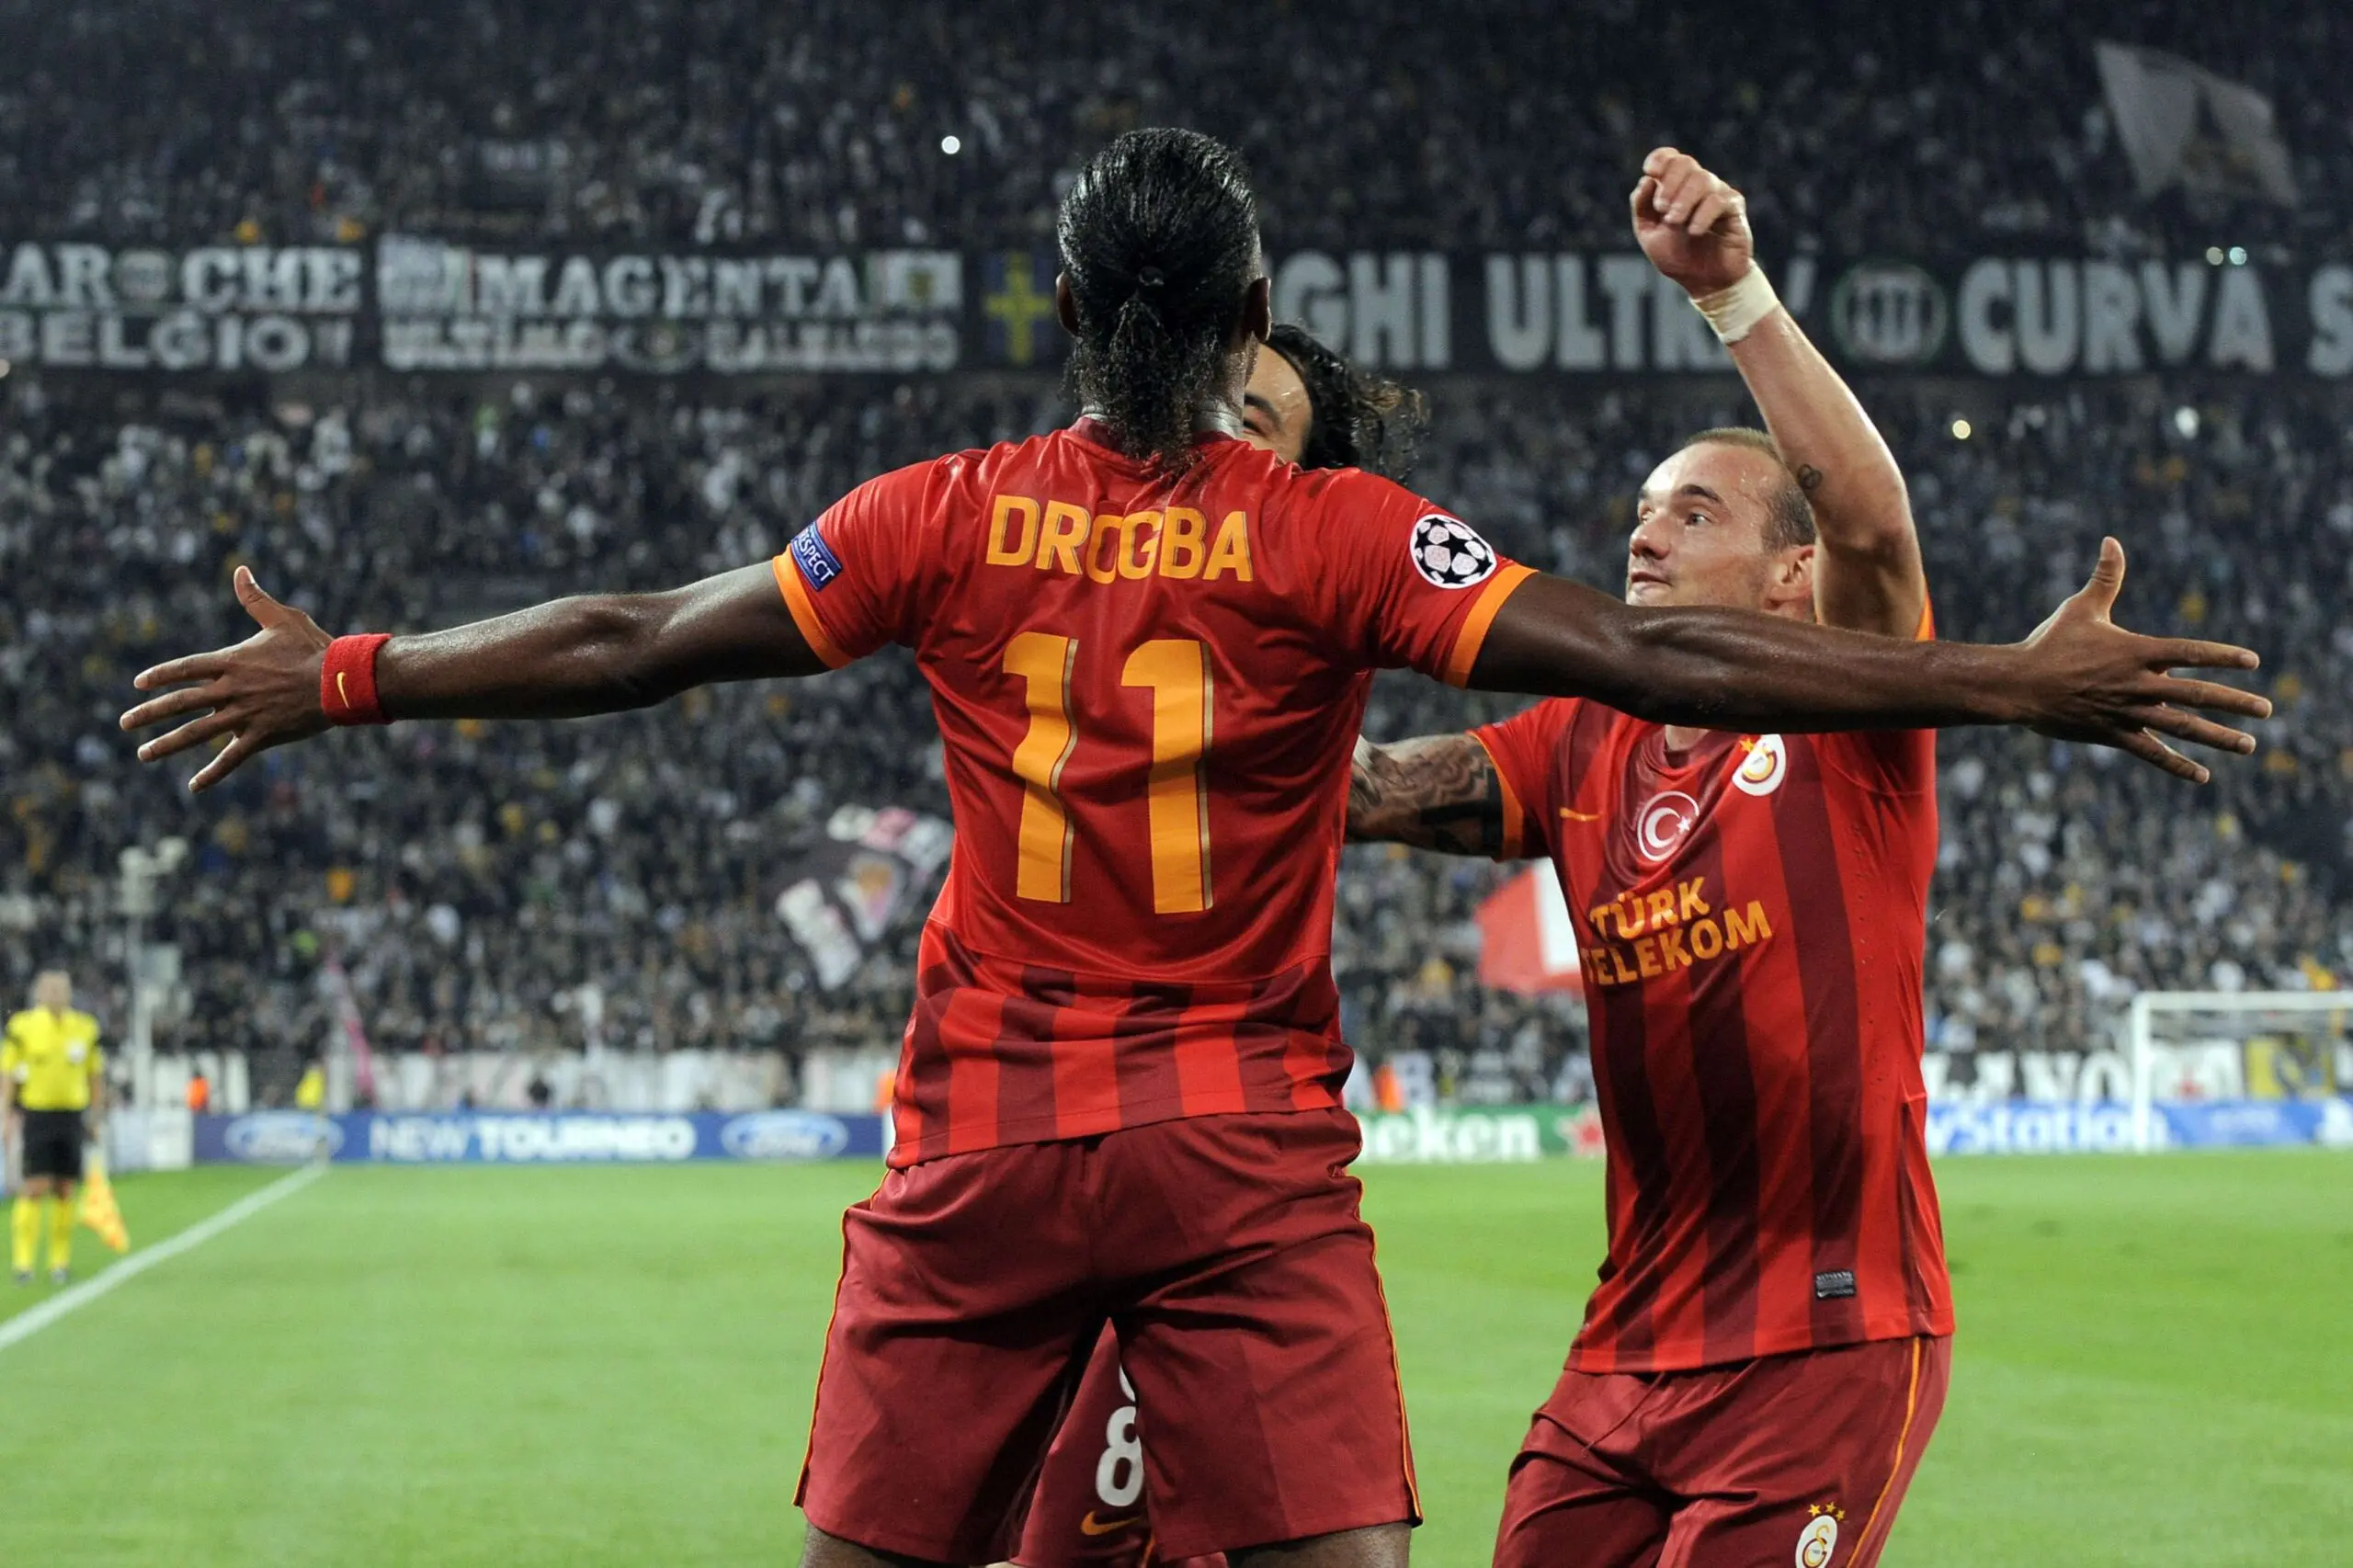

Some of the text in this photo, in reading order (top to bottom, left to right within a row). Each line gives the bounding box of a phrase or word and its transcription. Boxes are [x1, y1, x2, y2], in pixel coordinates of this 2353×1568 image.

[475, 252, 860, 317] MAGENTA
[1956, 256, 2273, 376] CURVA
[985, 494, 1254, 585] DROGBA
[1003, 631, 1215, 915] 11
[1589, 876, 1711, 939] TÜRK
[369, 1115, 697, 1162] NEW TOURNEO
[1096, 1405, 1144, 1507] 8
